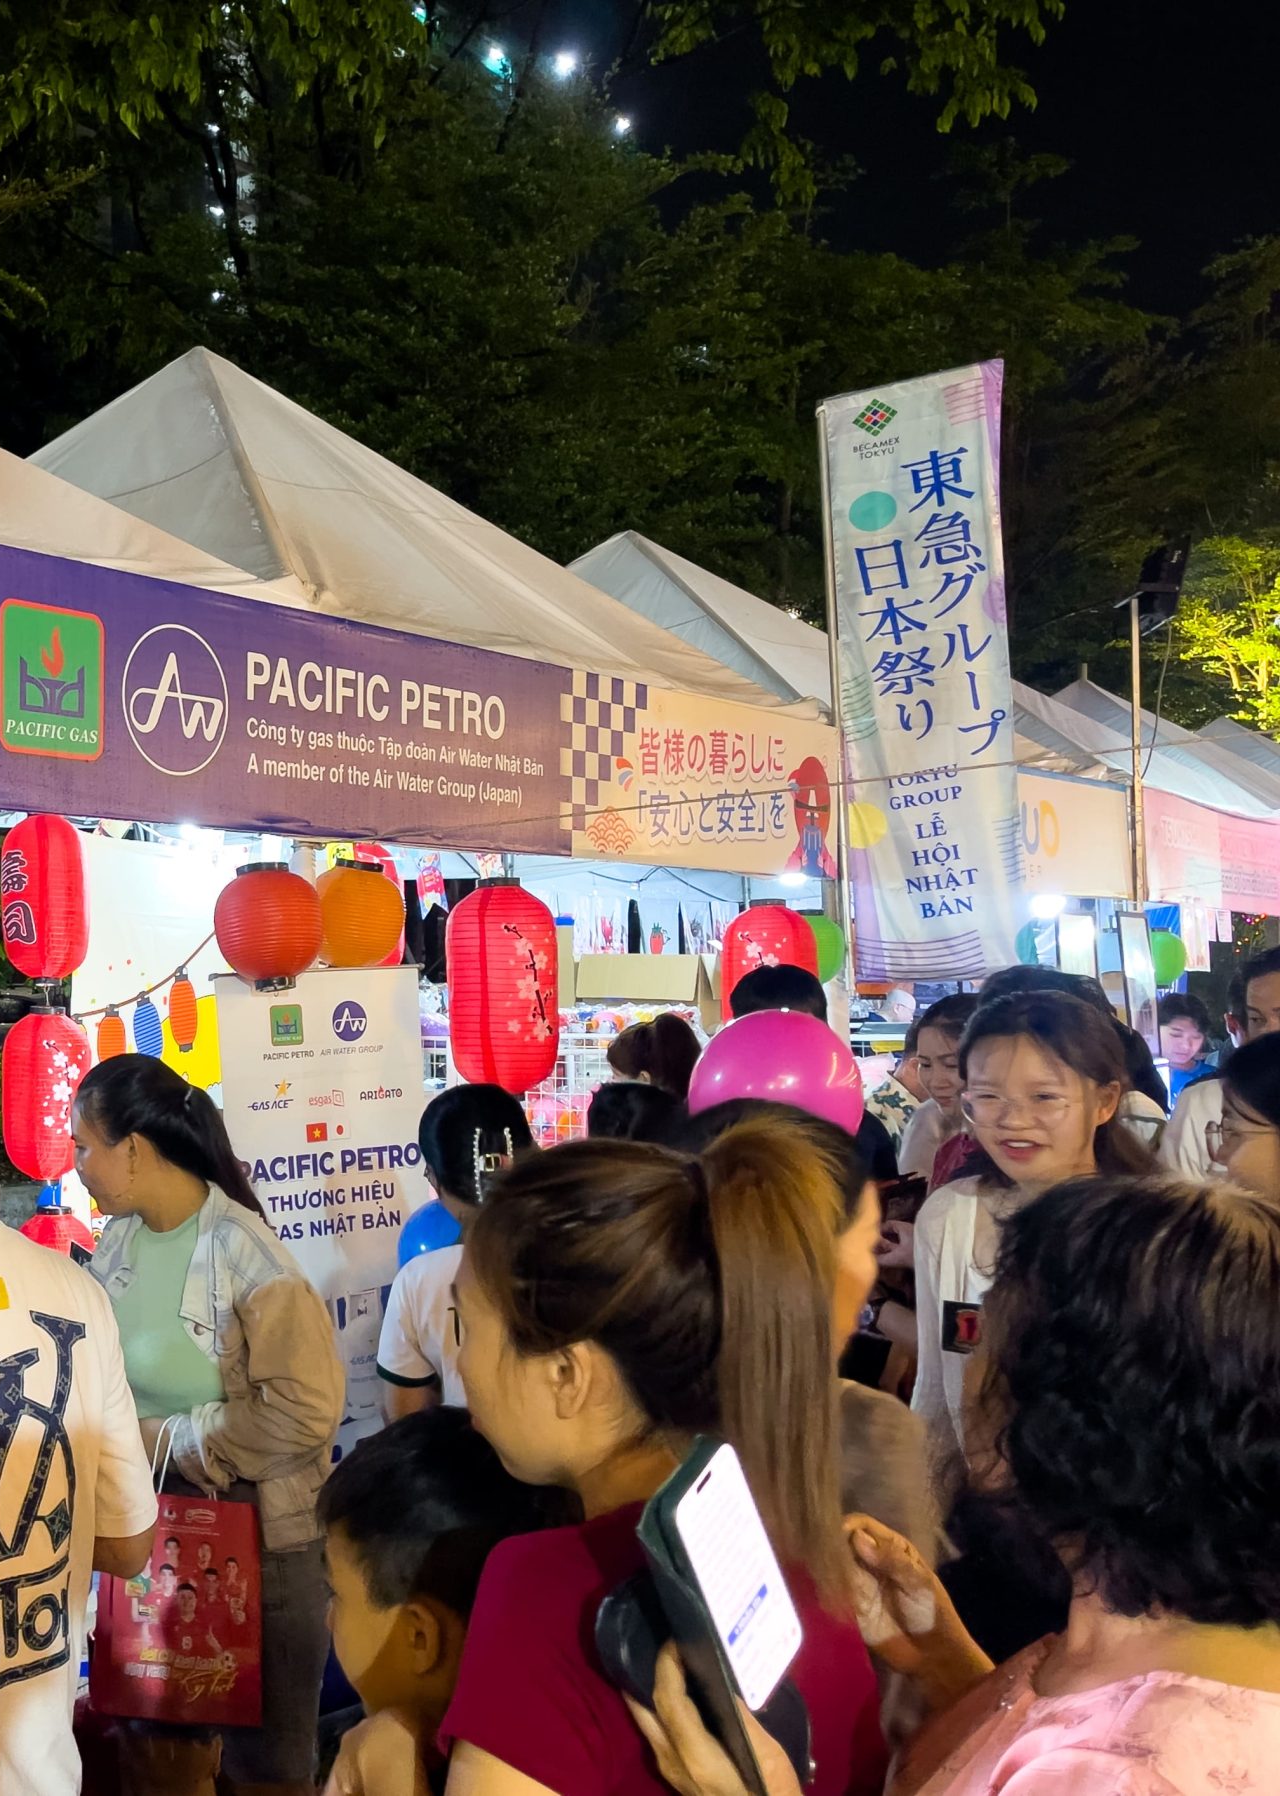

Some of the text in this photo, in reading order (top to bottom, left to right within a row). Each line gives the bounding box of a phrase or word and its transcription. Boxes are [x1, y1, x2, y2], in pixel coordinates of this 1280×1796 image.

[852, 436, 900, 453] BECAMEX
[860, 446, 895, 460] TOKYU
[901, 447, 1006, 756] 東急グループ
[854, 539, 936, 741] 日本祭り
[246, 651, 506, 741] PACIFIC PETRO
[6, 719, 98, 744] PACIFIC GAS
[246, 717, 544, 777] Công ty gas thuộc Tập đoàn Air Water Nhật Bản
[639, 727, 786, 776] 皆様の暮らしに
[247, 752, 522, 808] A member of the Air Water Group (Japan)
[889, 786, 962, 810] GROUP
[639, 788, 785, 838] 「安心と安全」を
[915, 812, 947, 839] LỄ
[912, 842, 961, 866] HỘI
[906, 868, 978, 894] NHẬT
[921, 895, 973, 919] BẢN
[263, 1050, 314, 1061] PACIFIC PETRO
[333, 1046, 356, 1055] WATER
[358, 1044, 384, 1054] GROUP
[248, 1099, 293, 1111] GAS ACE
[309, 1094, 332, 1107] esgas
[360, 1085, 402, 1101] ARIGATO
[341, 1143, 421, 1174] PETRO
[268, 1180, 395, 1213] THƯƠNG HIỆU
[310, 1213, 356, 1238] NHẬT
[363, 1208, 401, 1230] BẢN
